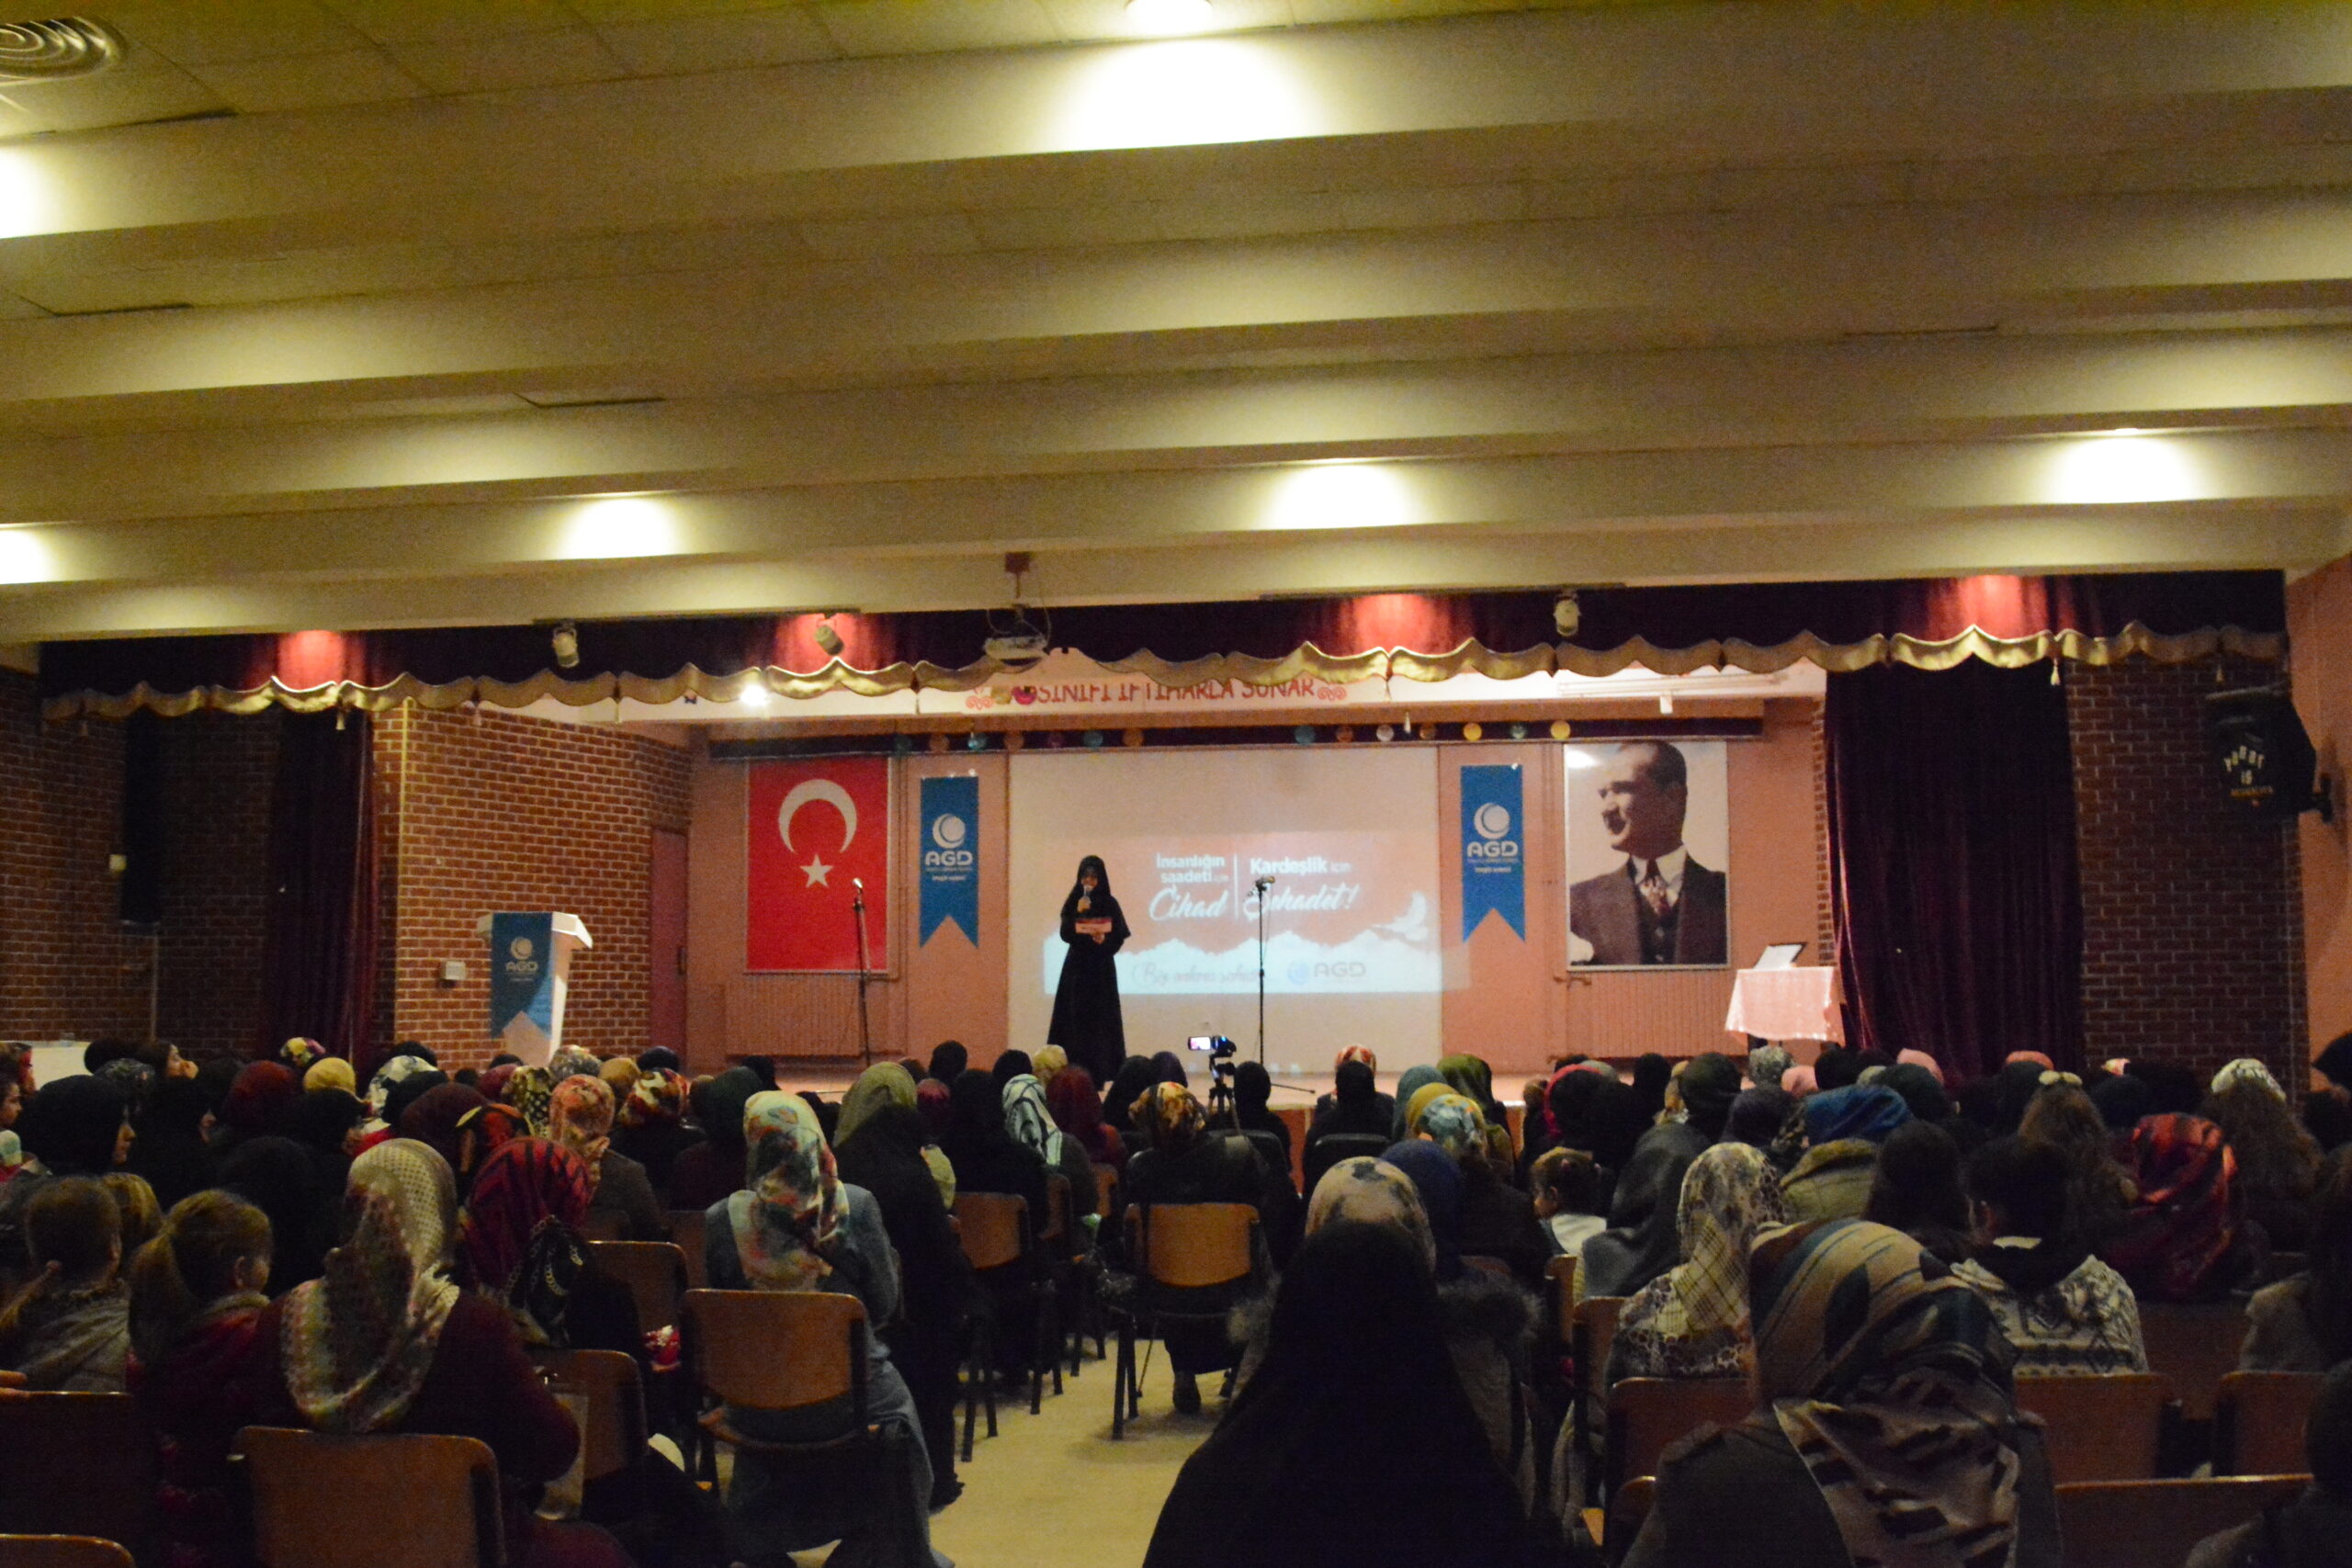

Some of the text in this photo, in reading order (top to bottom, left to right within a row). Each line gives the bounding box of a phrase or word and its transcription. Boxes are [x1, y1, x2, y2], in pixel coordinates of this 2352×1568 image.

[1467, 840, 1519, 857] AGD
[925, 851, 973, 866] AGD
[1250, 855, 1328, 876] Kardeşlik
[1313, 962, 1367, 978] AGD
